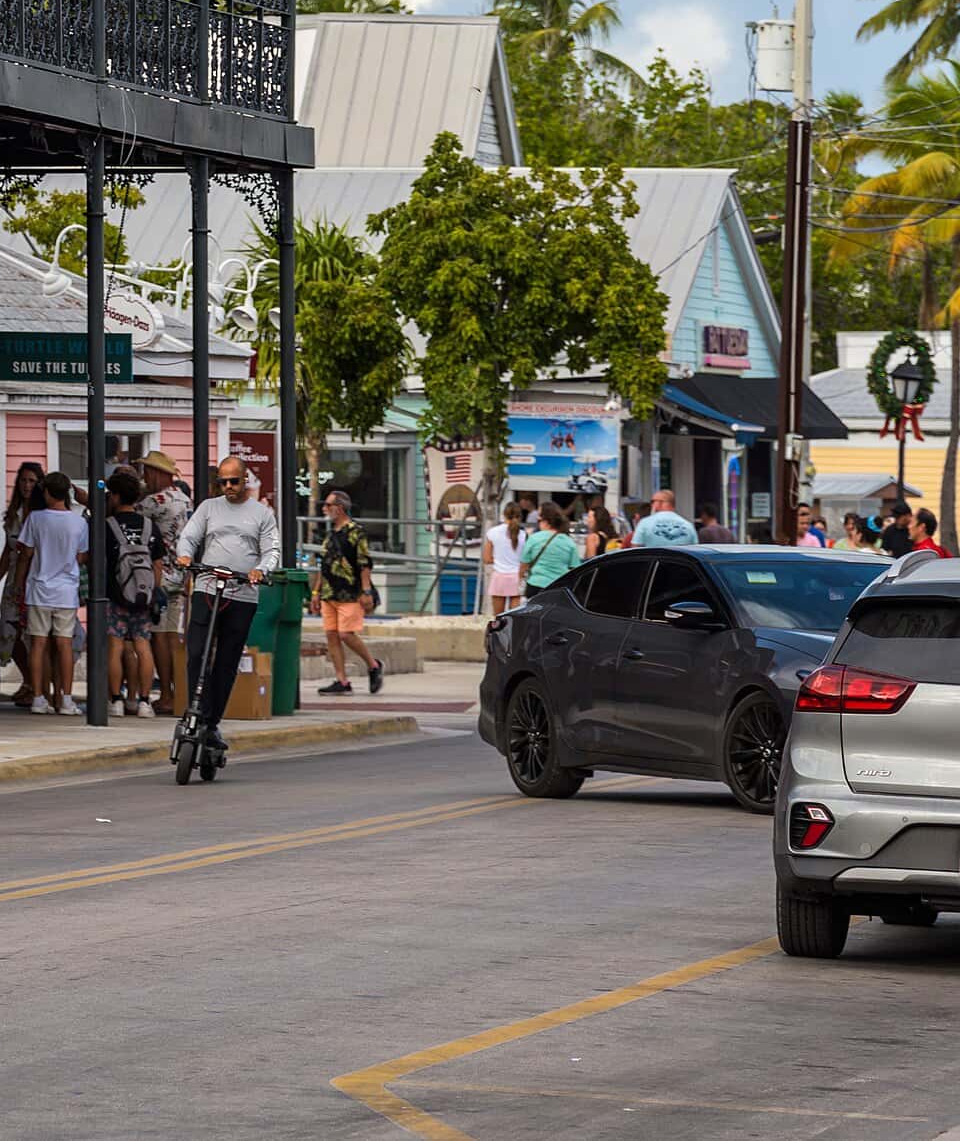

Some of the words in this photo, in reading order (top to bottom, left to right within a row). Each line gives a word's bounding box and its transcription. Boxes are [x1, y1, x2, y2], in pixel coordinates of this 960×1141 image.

[68, 340, 125, 356] WLD
[12, 361, 41, 373] SAVE
[46, 362, 67, 373] THE
[71, 363, 121, 374] TUES
